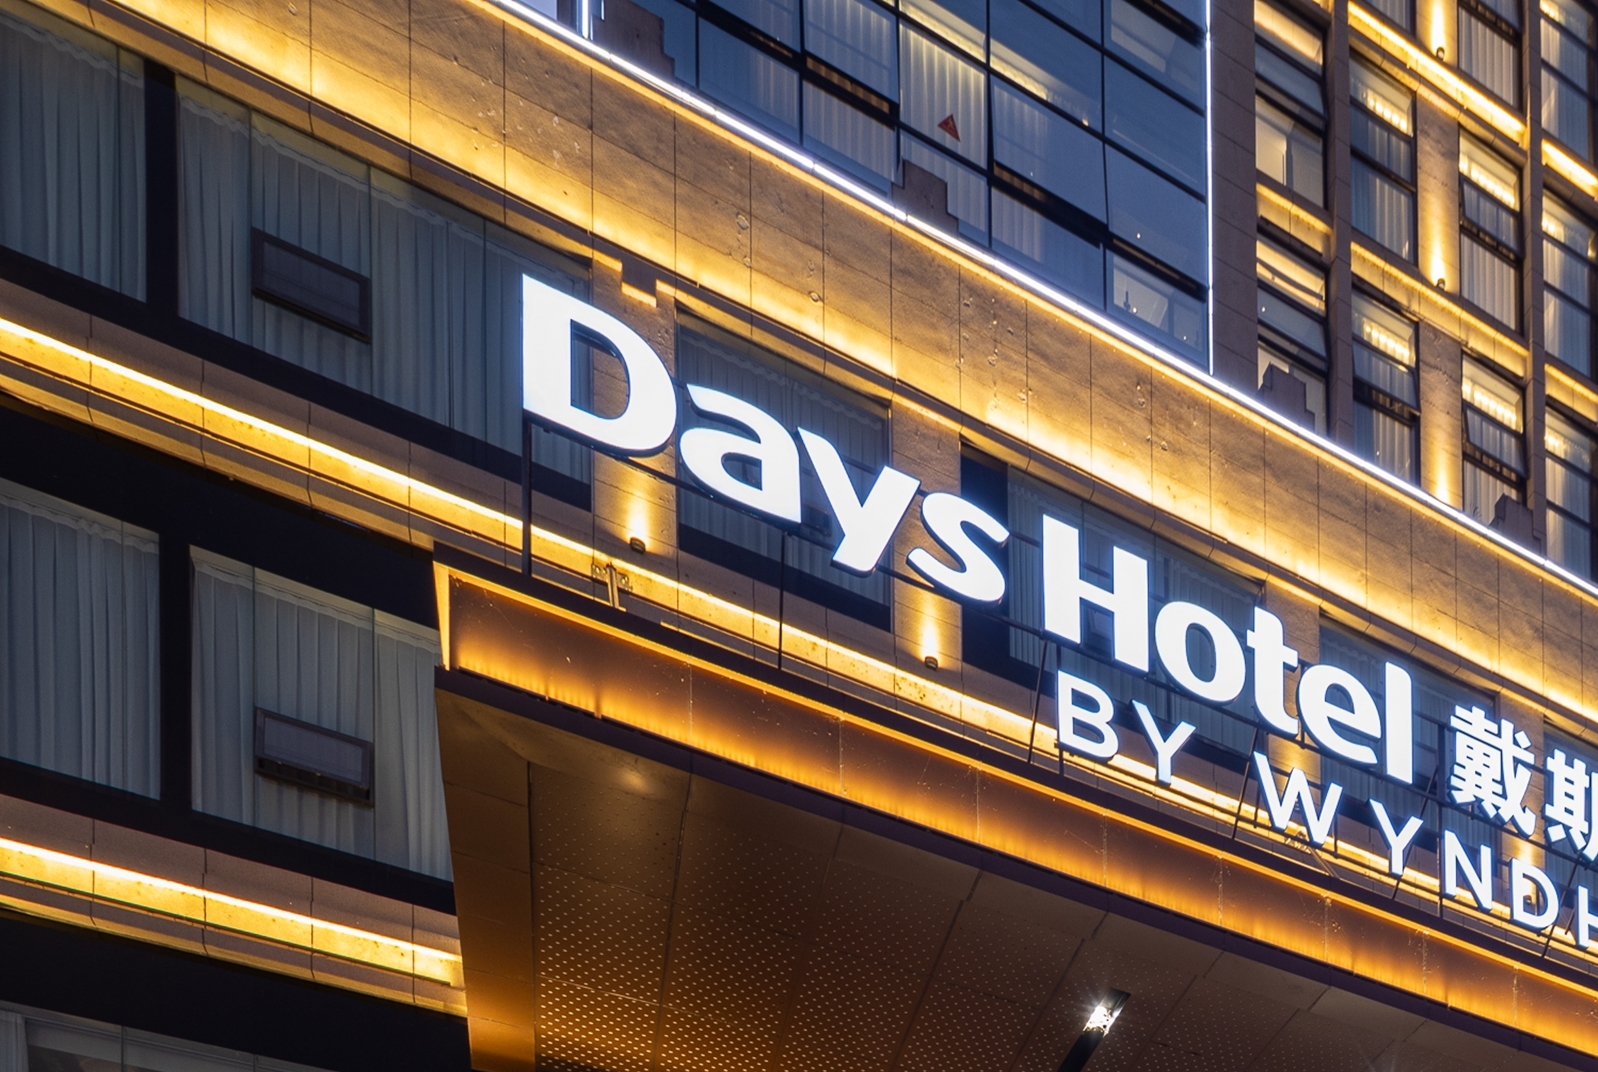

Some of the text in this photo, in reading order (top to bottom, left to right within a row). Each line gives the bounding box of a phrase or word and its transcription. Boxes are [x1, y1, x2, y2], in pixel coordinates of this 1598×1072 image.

[522, 274, 1413, 784] Days Hotel
[1057, 670, 1196, 784] BY
